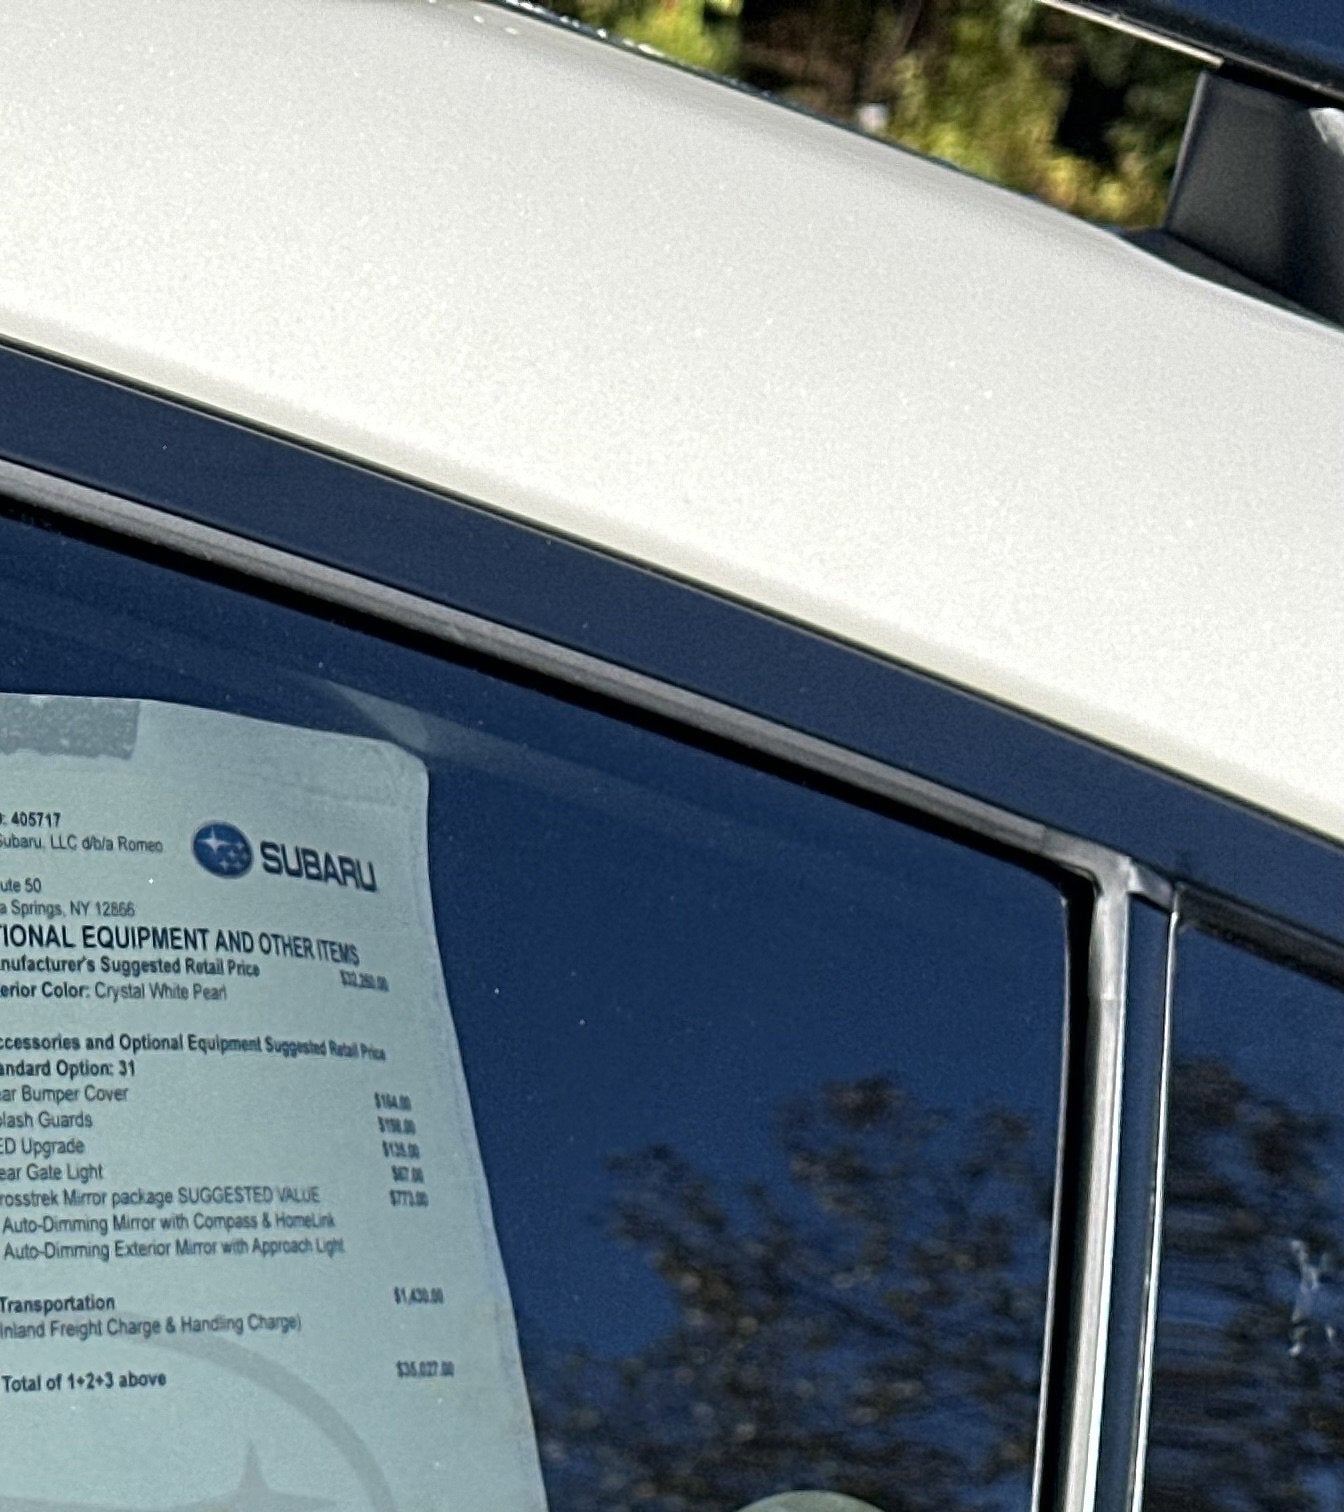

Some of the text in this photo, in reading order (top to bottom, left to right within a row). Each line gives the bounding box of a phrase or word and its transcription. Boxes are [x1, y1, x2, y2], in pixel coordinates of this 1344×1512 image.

[259, 840, 378, 894] SUBARU
[81, 924, 210, 951] EQUIPMENT
[215, 930, 255, 954] AND
[258, 932, 315, 959] OTHER
[316, 939, 360, 966] ITEMS
[21, 1084, 81, 1106] Bumper
[83, 1083, 129, 1103] Cover
